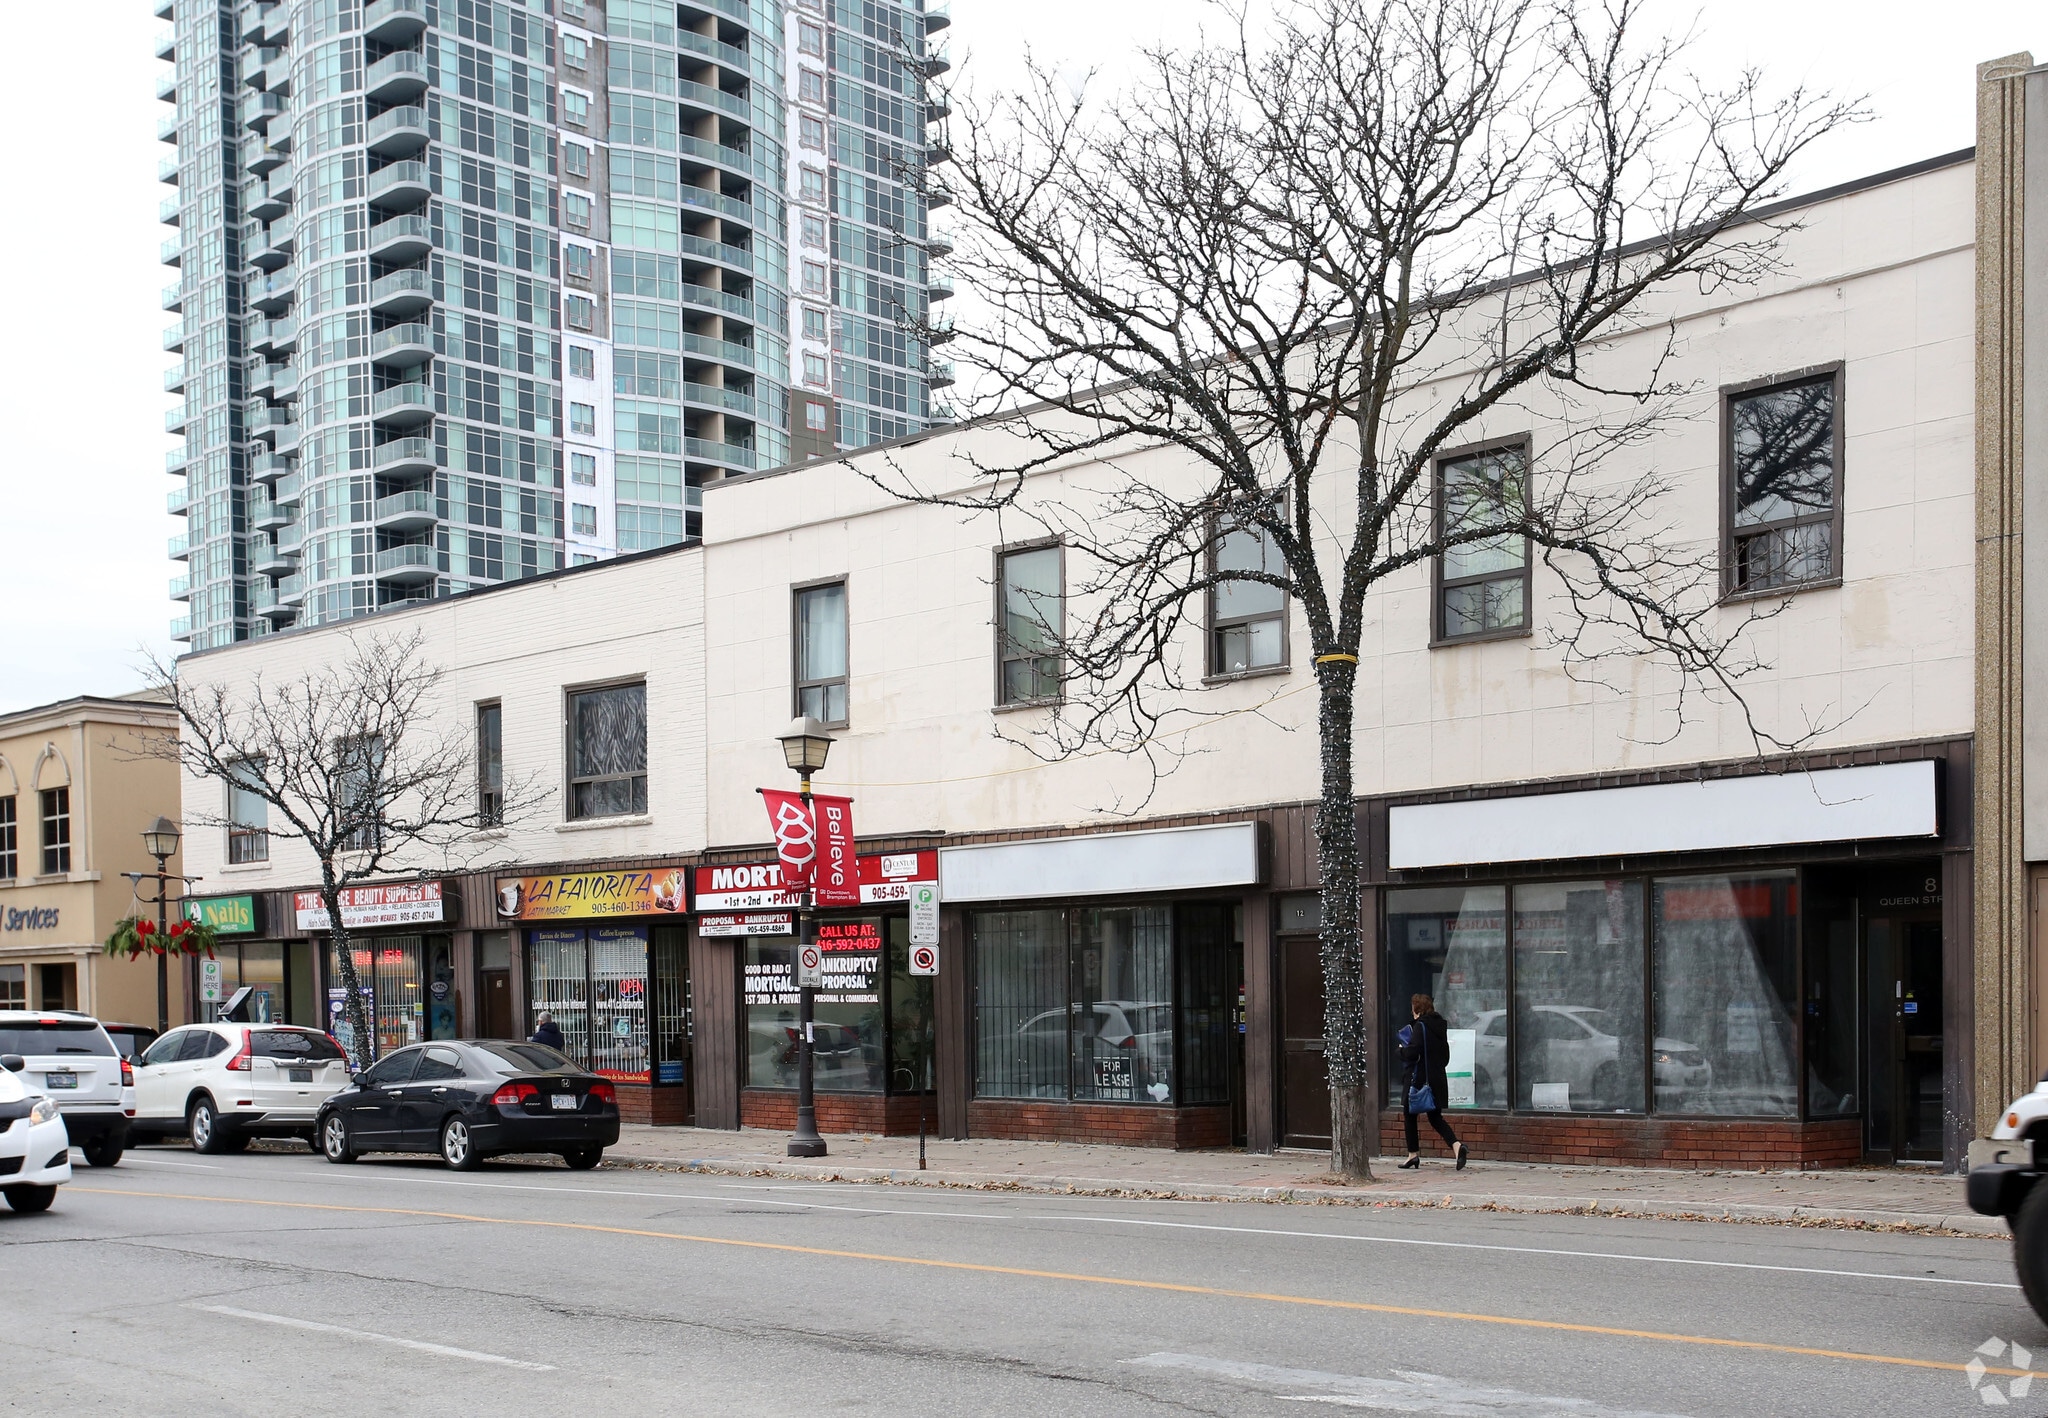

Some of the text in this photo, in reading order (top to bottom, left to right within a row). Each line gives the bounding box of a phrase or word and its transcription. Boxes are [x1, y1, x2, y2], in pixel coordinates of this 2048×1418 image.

[826, 806, 846, 886] Believe
[893, 859, 915, 867] CENTUM
[528, 872, 653, 903] LA FAVORITA
[1924, 877, 1937, 893] 8
[303, 893, 318, 909] THE
[354, 887, 384, 905] BEAUTY
[385, 884, 422, 903] SUPPLIES
[425, 883, 441, 900] INC.
[872, 885, 910, 900] 905-459-
[416, 901, 440, 909] COSMETICS
[591, 900, 652, 914] 905-460-1346
[728, 896, 740, 907] 1st
[747, 895, 761, 906] 2nd
[1879, 895, 1943, 906] QUEEN STR
[206, 900, 249, 926] Nails
[526, 905, 572, 917] LATIN MARKET
[5, 905, 60, 931] Services
[702, 913, 788, 926] PROPOSAL BANKRUPTCY
[599, 929, 615, 937] Coffee
[747, 925, 785, 933] 905-459-4869
[820, 924, 876, 938] CALL US AT:
[816, 937, 881, 951] 416-592-0437
[745, 964, 761, 975] GOOD
[762, 964, 771, 975] OR
[771, 963, 784, 974] BAD
[821, 956, 878, 973] ANKRUPTCY
[203, 982, 219, 990] HERE
[619, 978, 644, 993] OPEN
[821, 975, 867, 989] PROPOSAL
[745, 993, 801, 1005] 1ST 2ND & PRIVAT
[814, 994, 879, 1003] PERSONAL & COMMERCIAL
[532, 999, 544, 1010] Look
[544, 1001, 549, 1010] us
[549, 1001, 555, 1012] up
[555, 1001, 561, 1010] on
[562, 1000, 570, 1010] the
[1102, 1061, 1121, 1072] FOR
[624, 1073, 649, 1081] Sandwiches
[1095, 1073, 1130, 1087] LEASE
